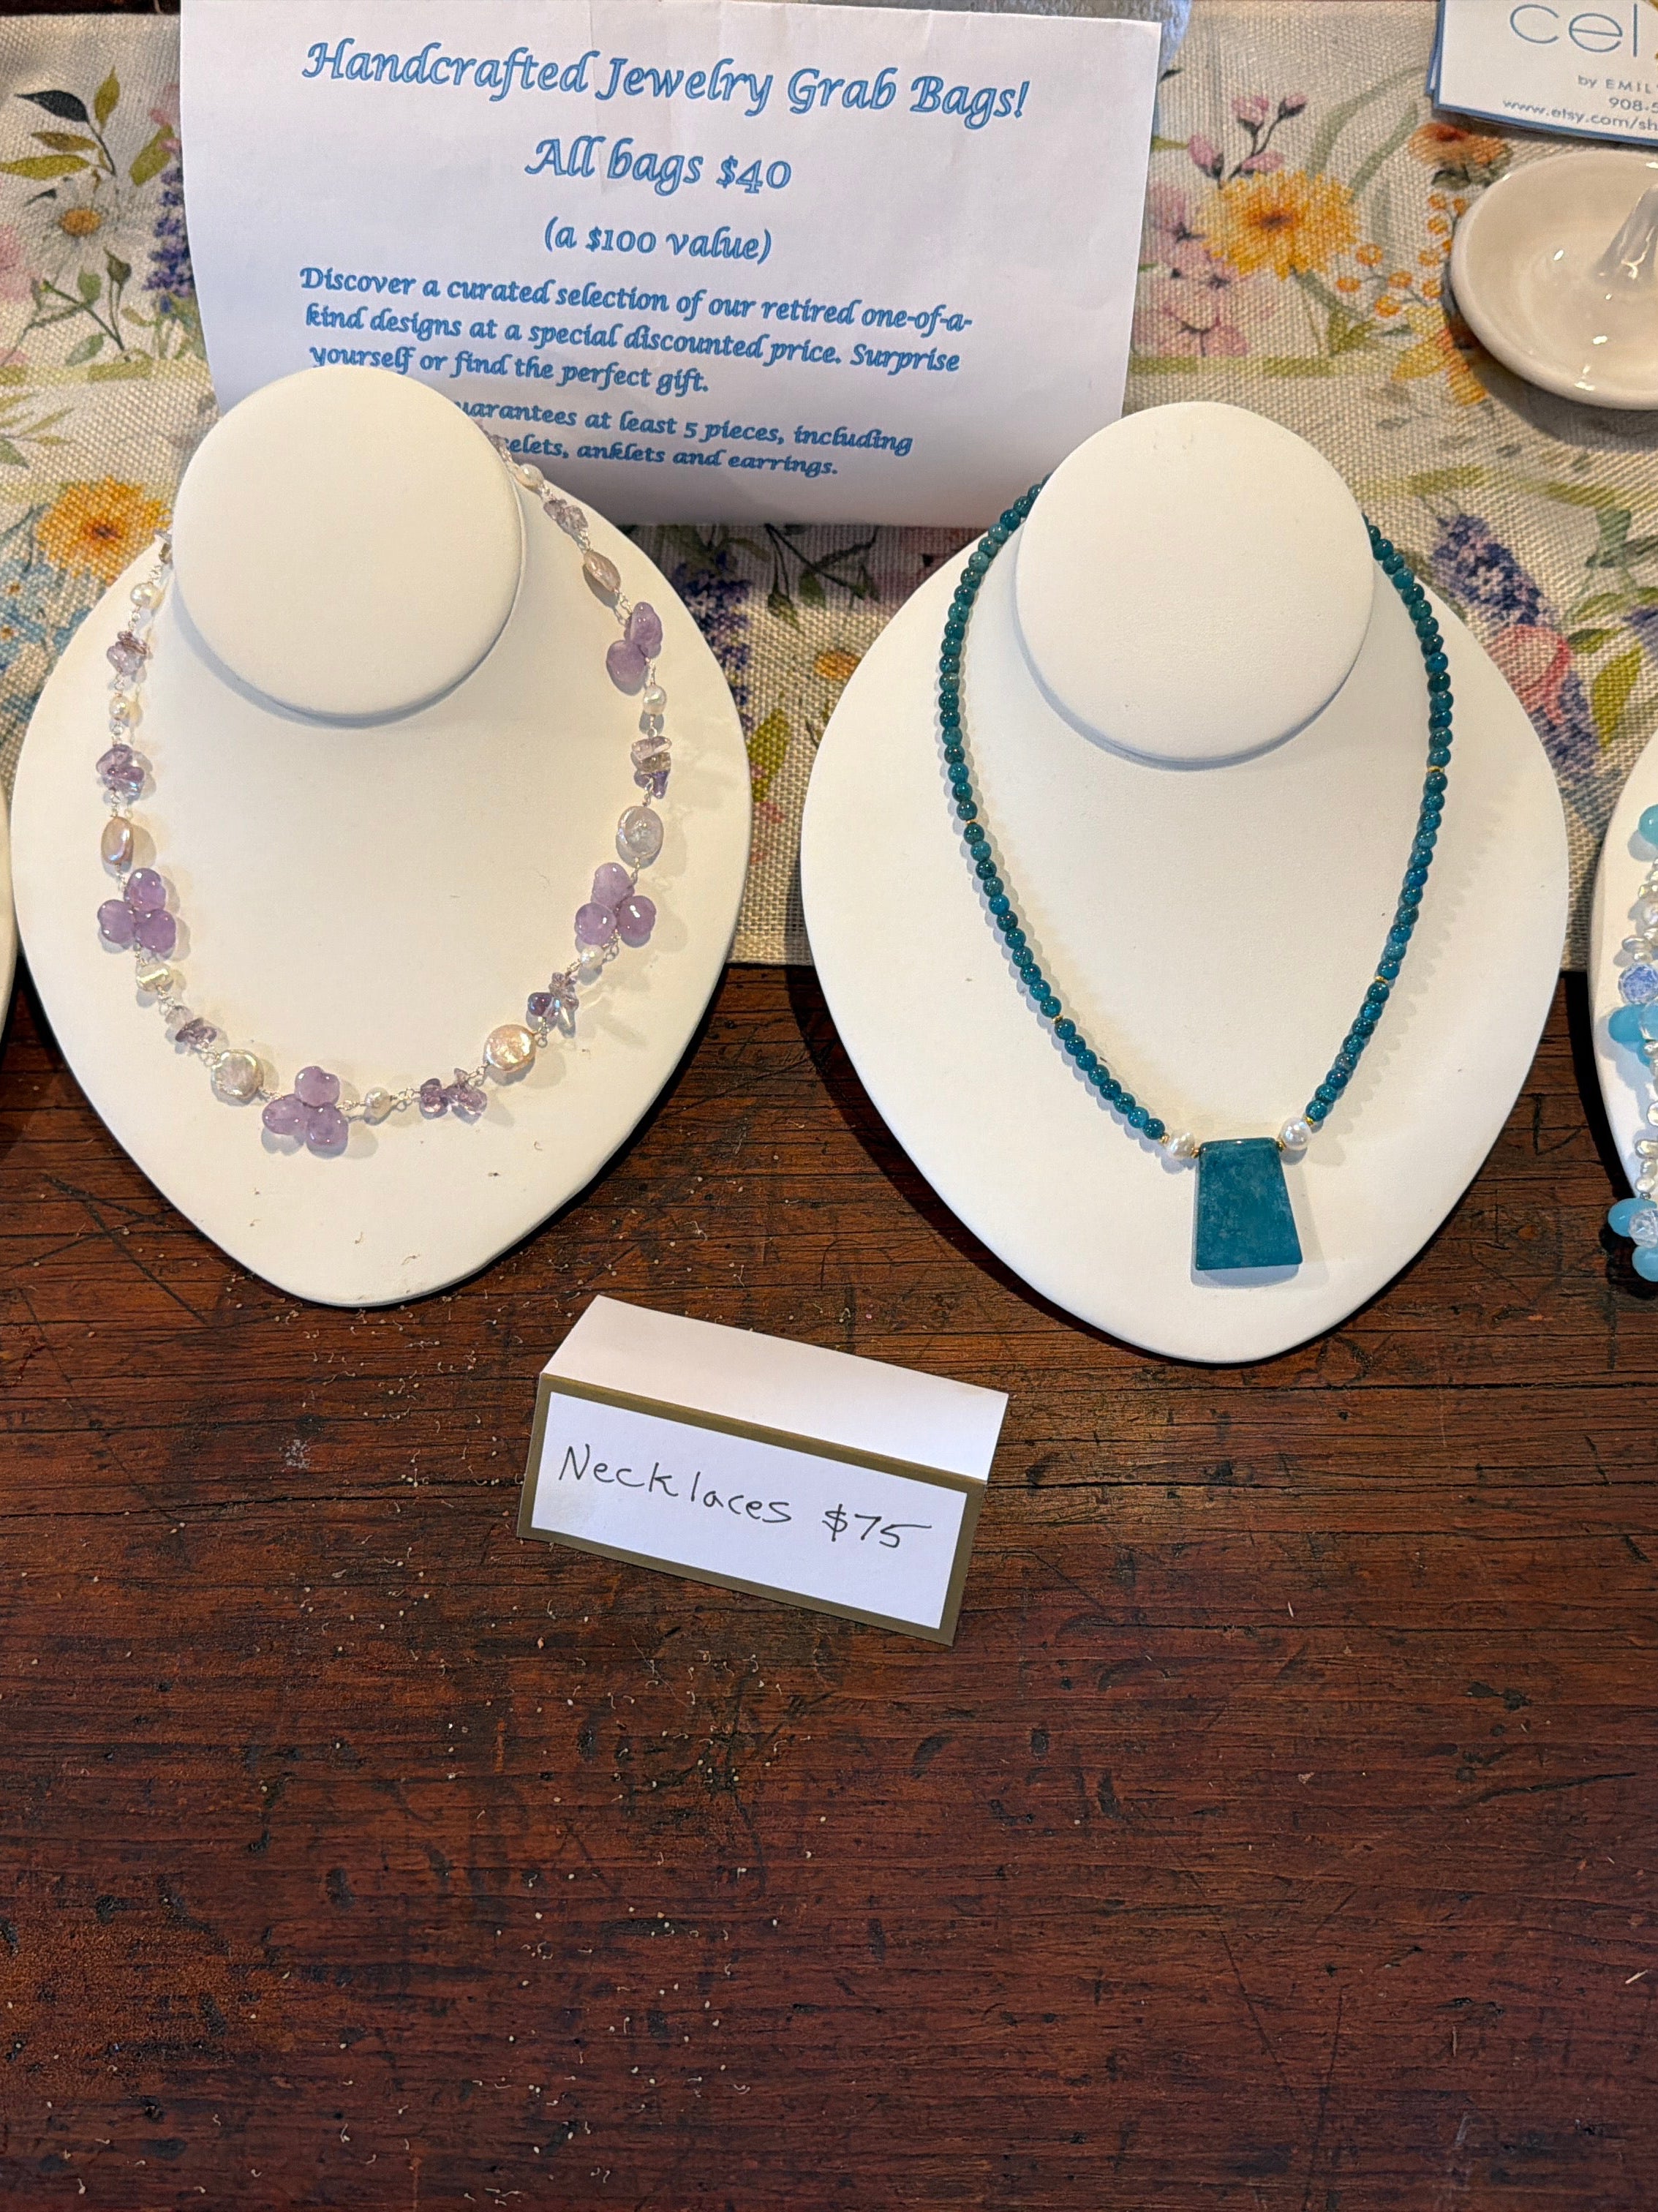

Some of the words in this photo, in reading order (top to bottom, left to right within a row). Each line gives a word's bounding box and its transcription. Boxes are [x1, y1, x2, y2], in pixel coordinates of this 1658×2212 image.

[301, 37, 601, 102] Handcrafted
[595, 56, 774, 118] Jewelry
[787, 67, 899, 115] Grab
[909, 75, 1030, 130] Bags!
[1578, 75, 1597, 89] by
[1605, 78, 1658, 94] EMIL
[524, 135, 607, 177] All
[606, 137, 704, 196] bags
[717, 154, 792, 195] $40
[544, 217, 577, 252] (a
[585, 226, 657, 254] $100
[666, 226, 772, 266] value)
[299, 267, 415, 296] Discover
[423, 279, 440, 297] a
[447, 279, 556, 305] curated
[554, 282, 669, 312] selection
[675, 289, 708, 321] of
[708, 298, 756, 319] our
[761, 298, 862, 326] retired
[861, 304, 973, 338] one-of-a-
[306, 303, 369, 329] kind
[370, 306, 461, 342] designs
[469, 318, 498, 339] at
[505, 323, 522, 341] a
[528, 323, 624, 350] special
[624, 324, 771, 358] discounted
[764, 339, 841, 367] price.
[850, 343, 962, 376] Surprise
[309, 346, 417, 375] yourself
[419, 355, 449, 372] or
[449, 350, 513, 378] find
[514, 356, 554, 379] the
[556, 361, 651, 391] perfect
[656, 367, 709, 397] gift.
[453, 401, 578, 426] uarantees
[584, 413, 613, 429] at
[619, 410, 677, 434] least
[685, 421, 698, 439] 5
[700, 420, 785, 446] pieces,
[793, 424, 914, 456] including
[506, 434, 569, 459] elets,
[576, 437, 666, 463] anklets
[673, 449, 726, 467] and
[728, 455, 837, 478] earrings.
[558, 1444, 792, 1523] Necklaces
[821, 1503, 932, 1549] $75
